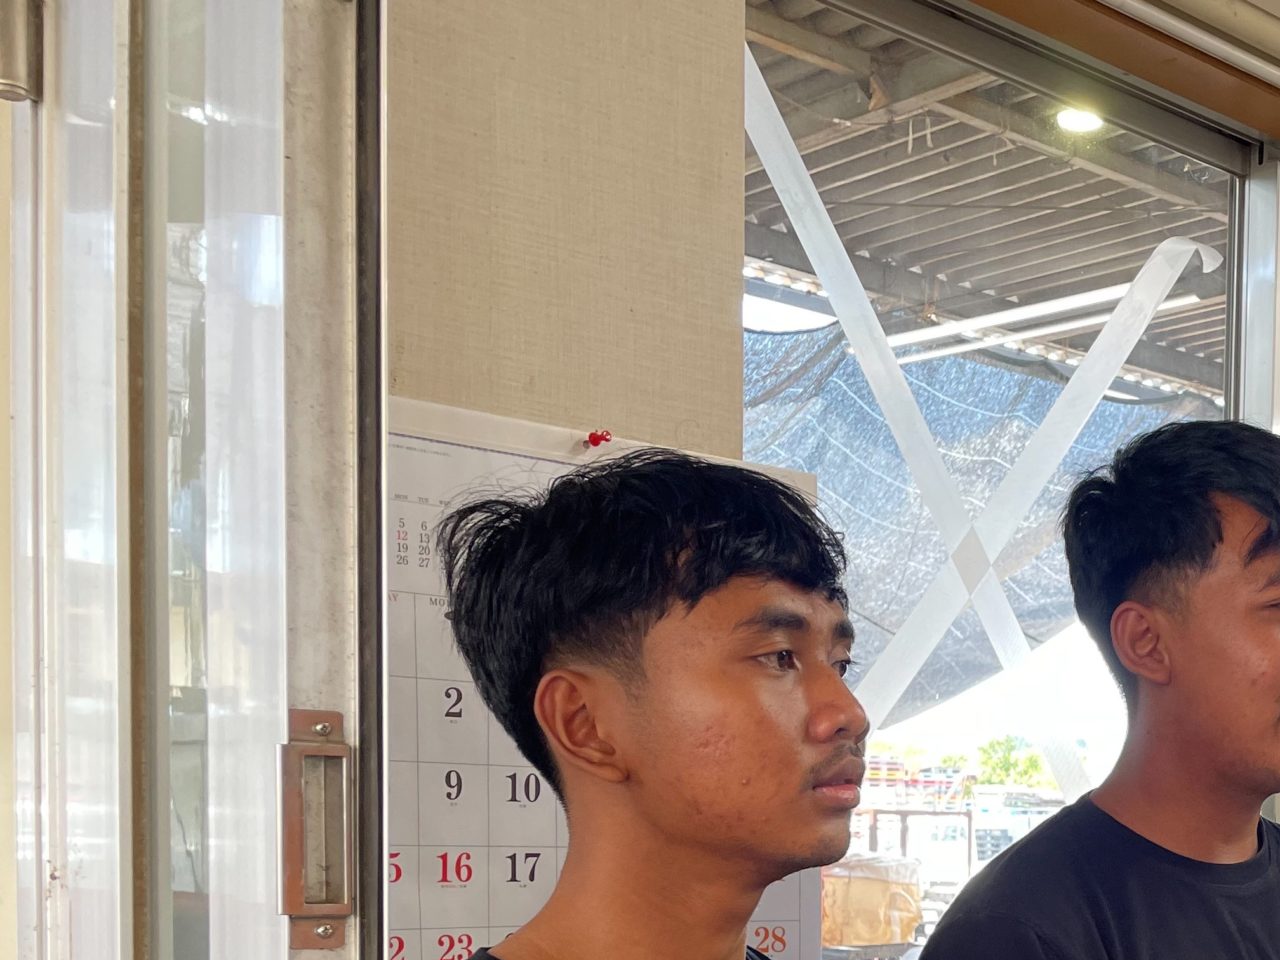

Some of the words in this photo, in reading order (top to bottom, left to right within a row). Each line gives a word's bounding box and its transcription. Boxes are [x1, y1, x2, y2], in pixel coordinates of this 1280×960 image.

[444, 686, 463, 718] 2
[444, 769, 463, 801] 9
[505, 772, 541, 803] 10
[436, 852, 473, 883] 16
[505, 853, 541, 882] 17
[754, 926, 786, 953] 28
